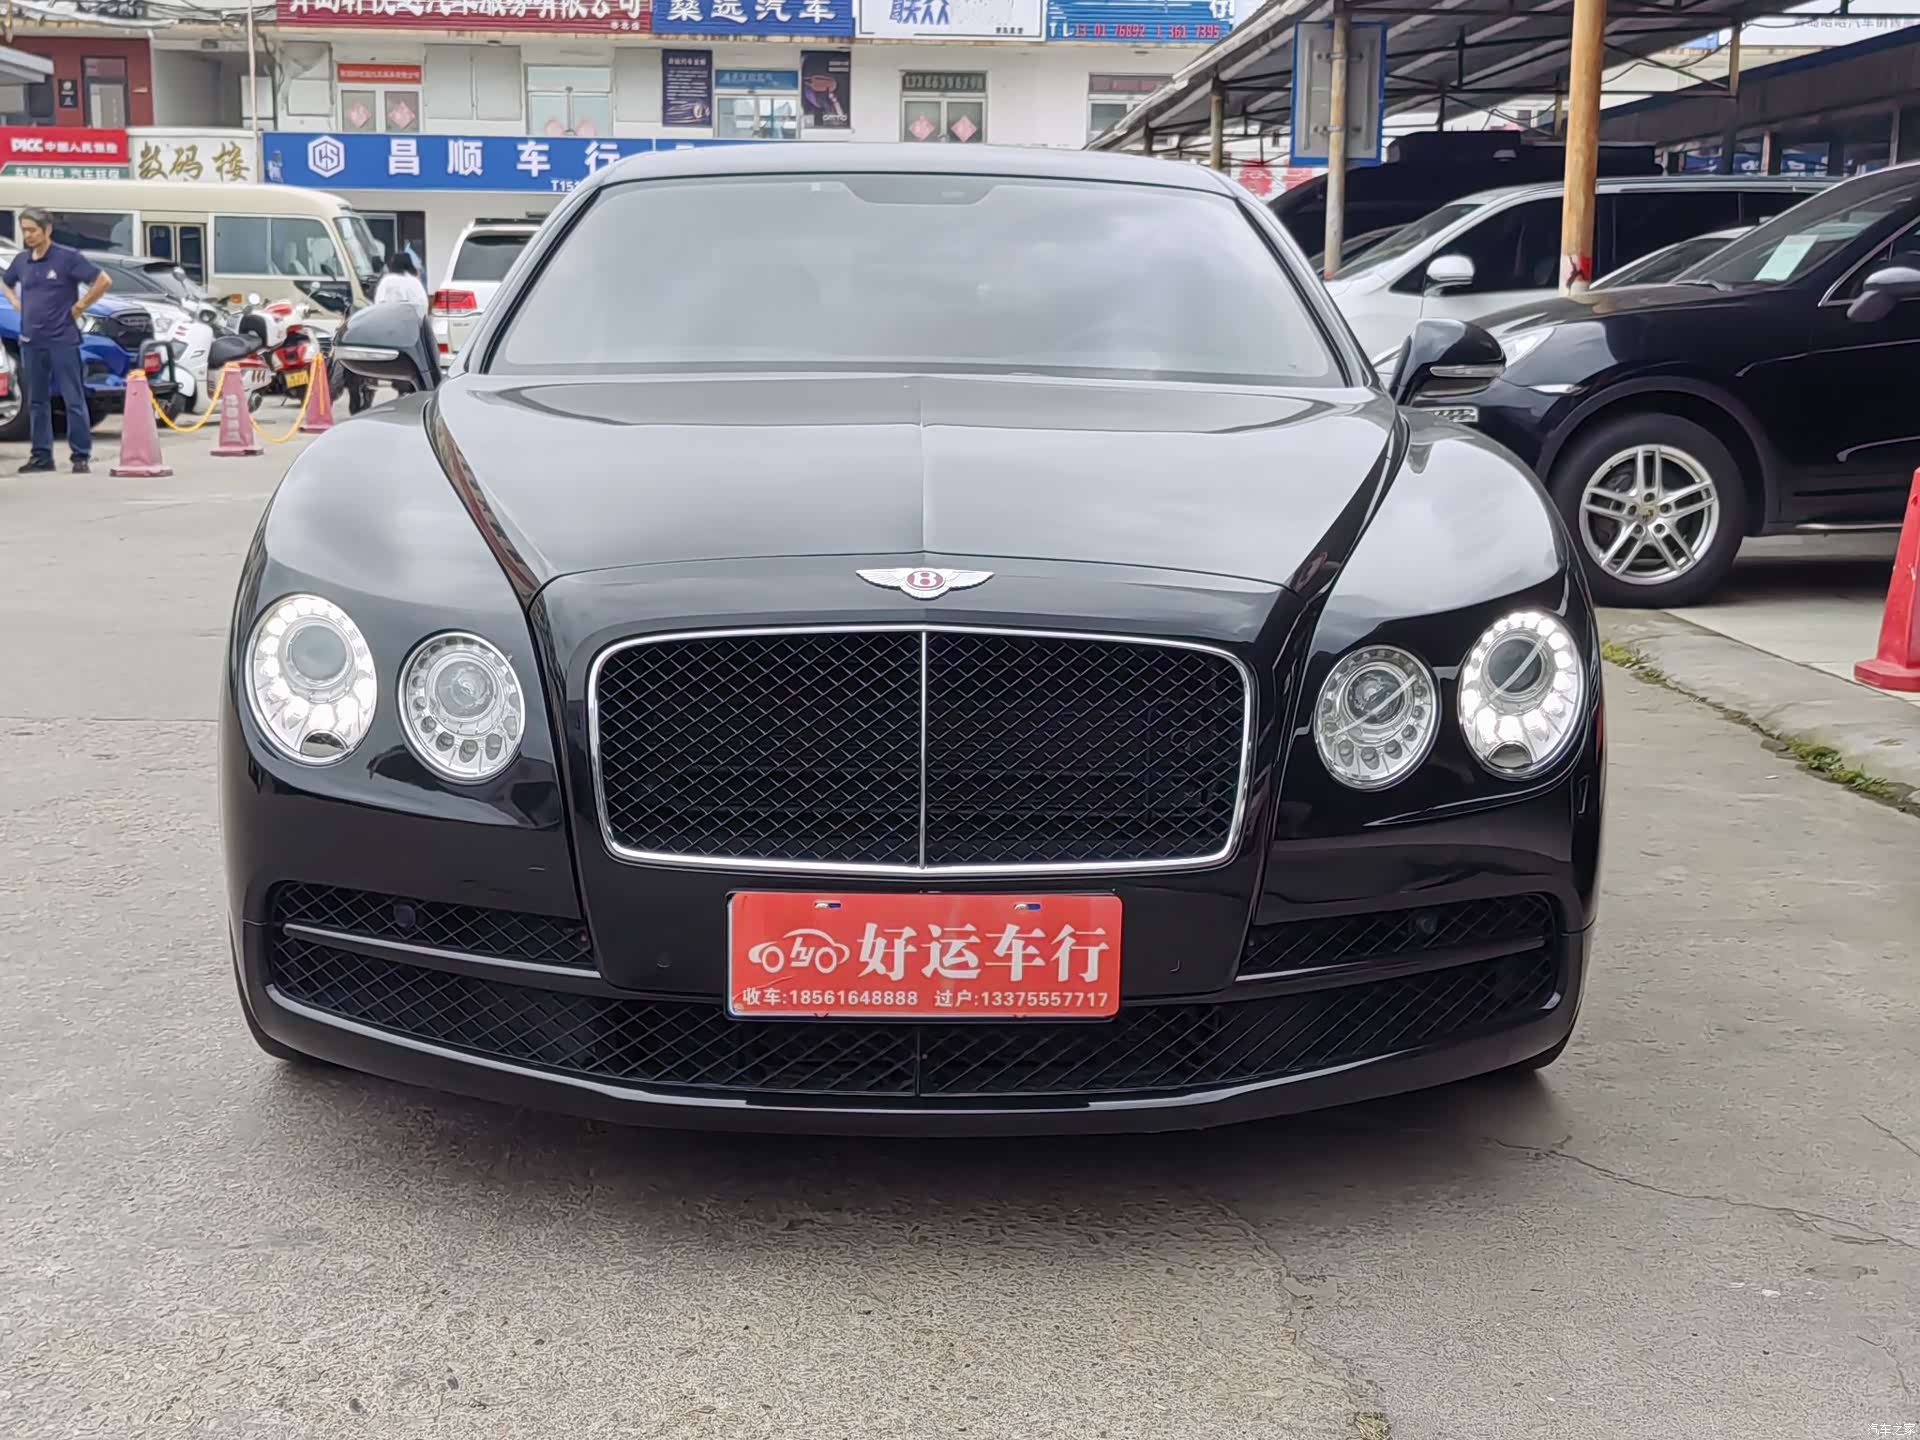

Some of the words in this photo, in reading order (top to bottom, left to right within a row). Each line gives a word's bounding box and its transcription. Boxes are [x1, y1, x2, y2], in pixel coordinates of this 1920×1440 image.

[11, 138, 43, 153] PICC
[138, 140, 250, 182] 数码楼
[389, 138, 621, 176] 昌顺车行
[857, 922, 1109, 983] 好运车行
